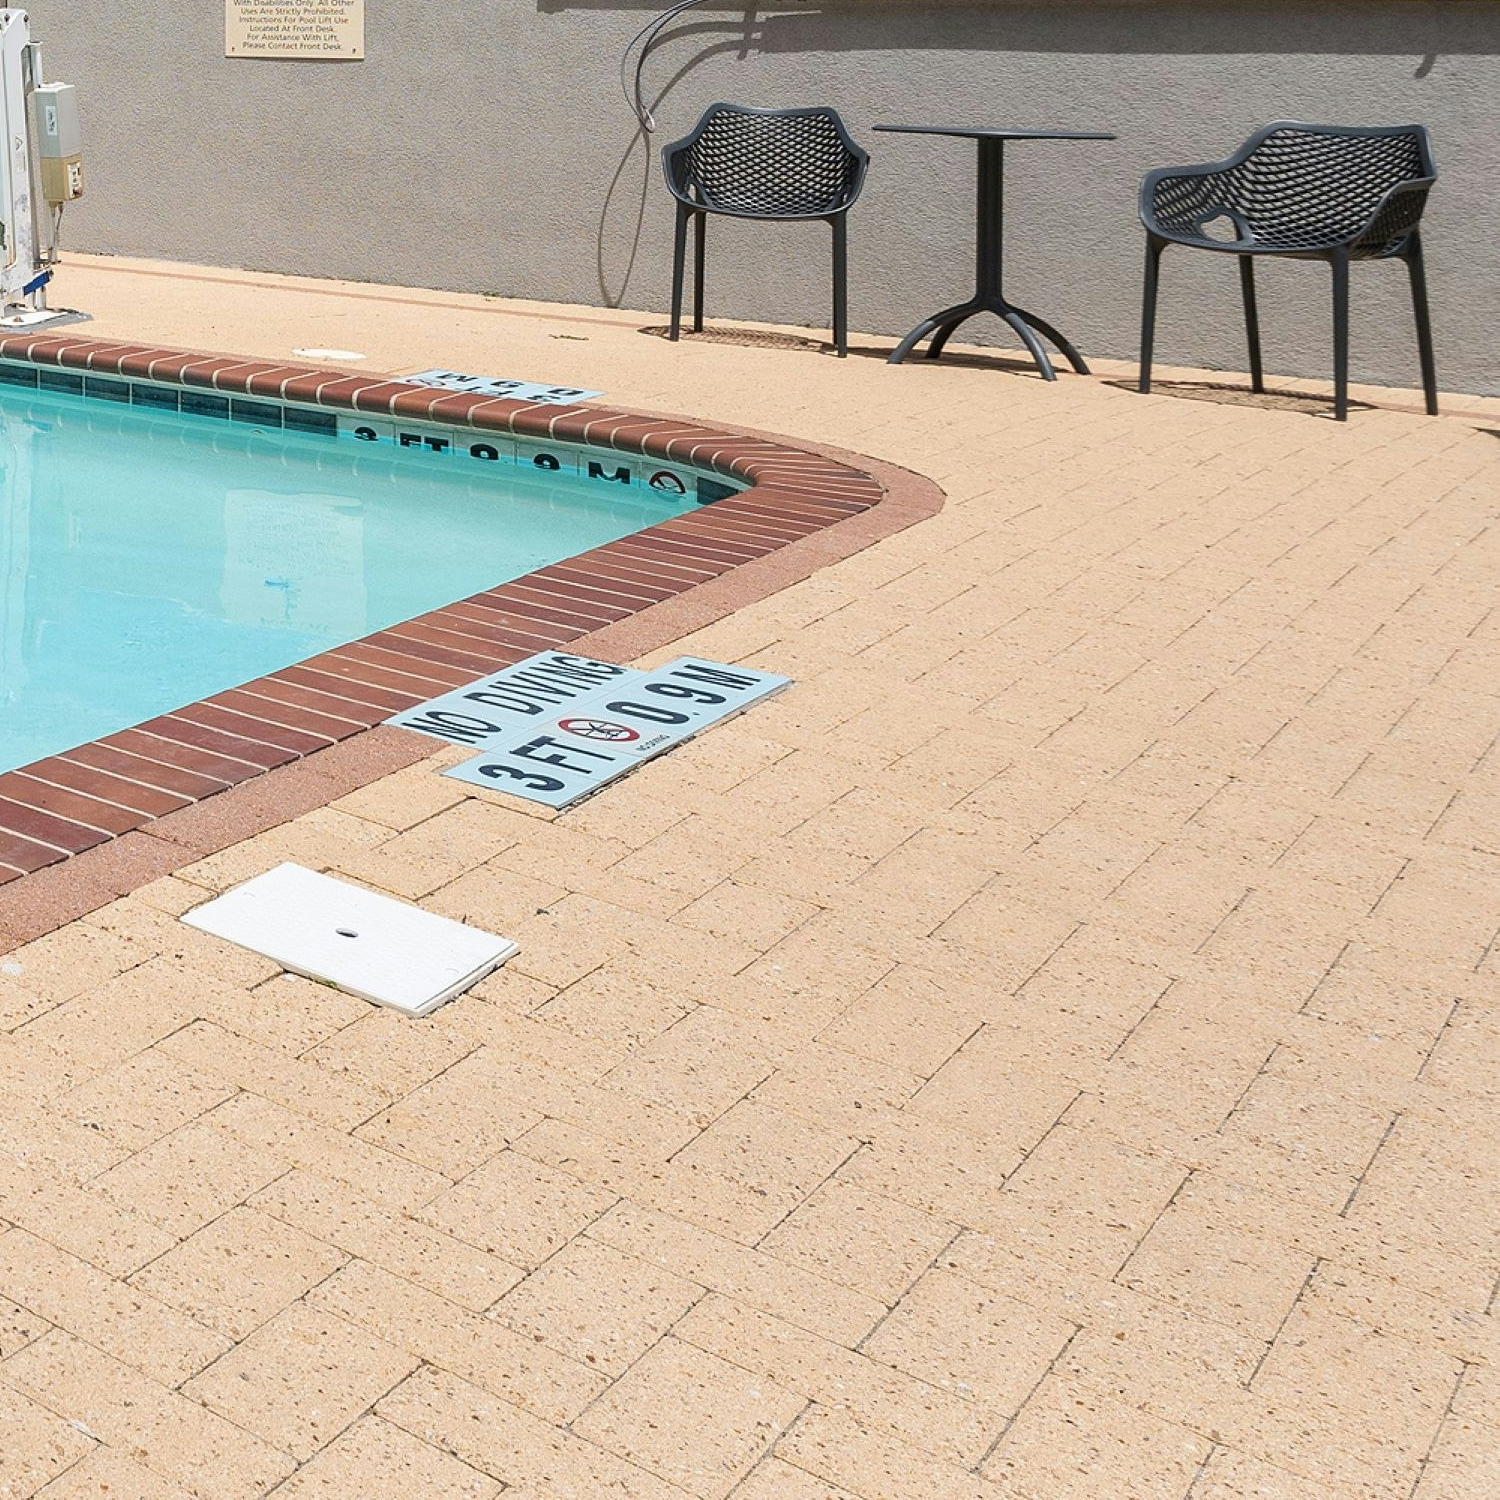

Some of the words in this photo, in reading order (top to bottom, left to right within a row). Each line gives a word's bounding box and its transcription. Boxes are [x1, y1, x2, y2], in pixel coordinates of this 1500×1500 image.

[670, 663, 762, 691] M
[401, 709, 502, 745] NO
[462, 655, 628, 716] DIVING
[509, 735, 616, 774] FT
[478, 763, 566, 791] 3
